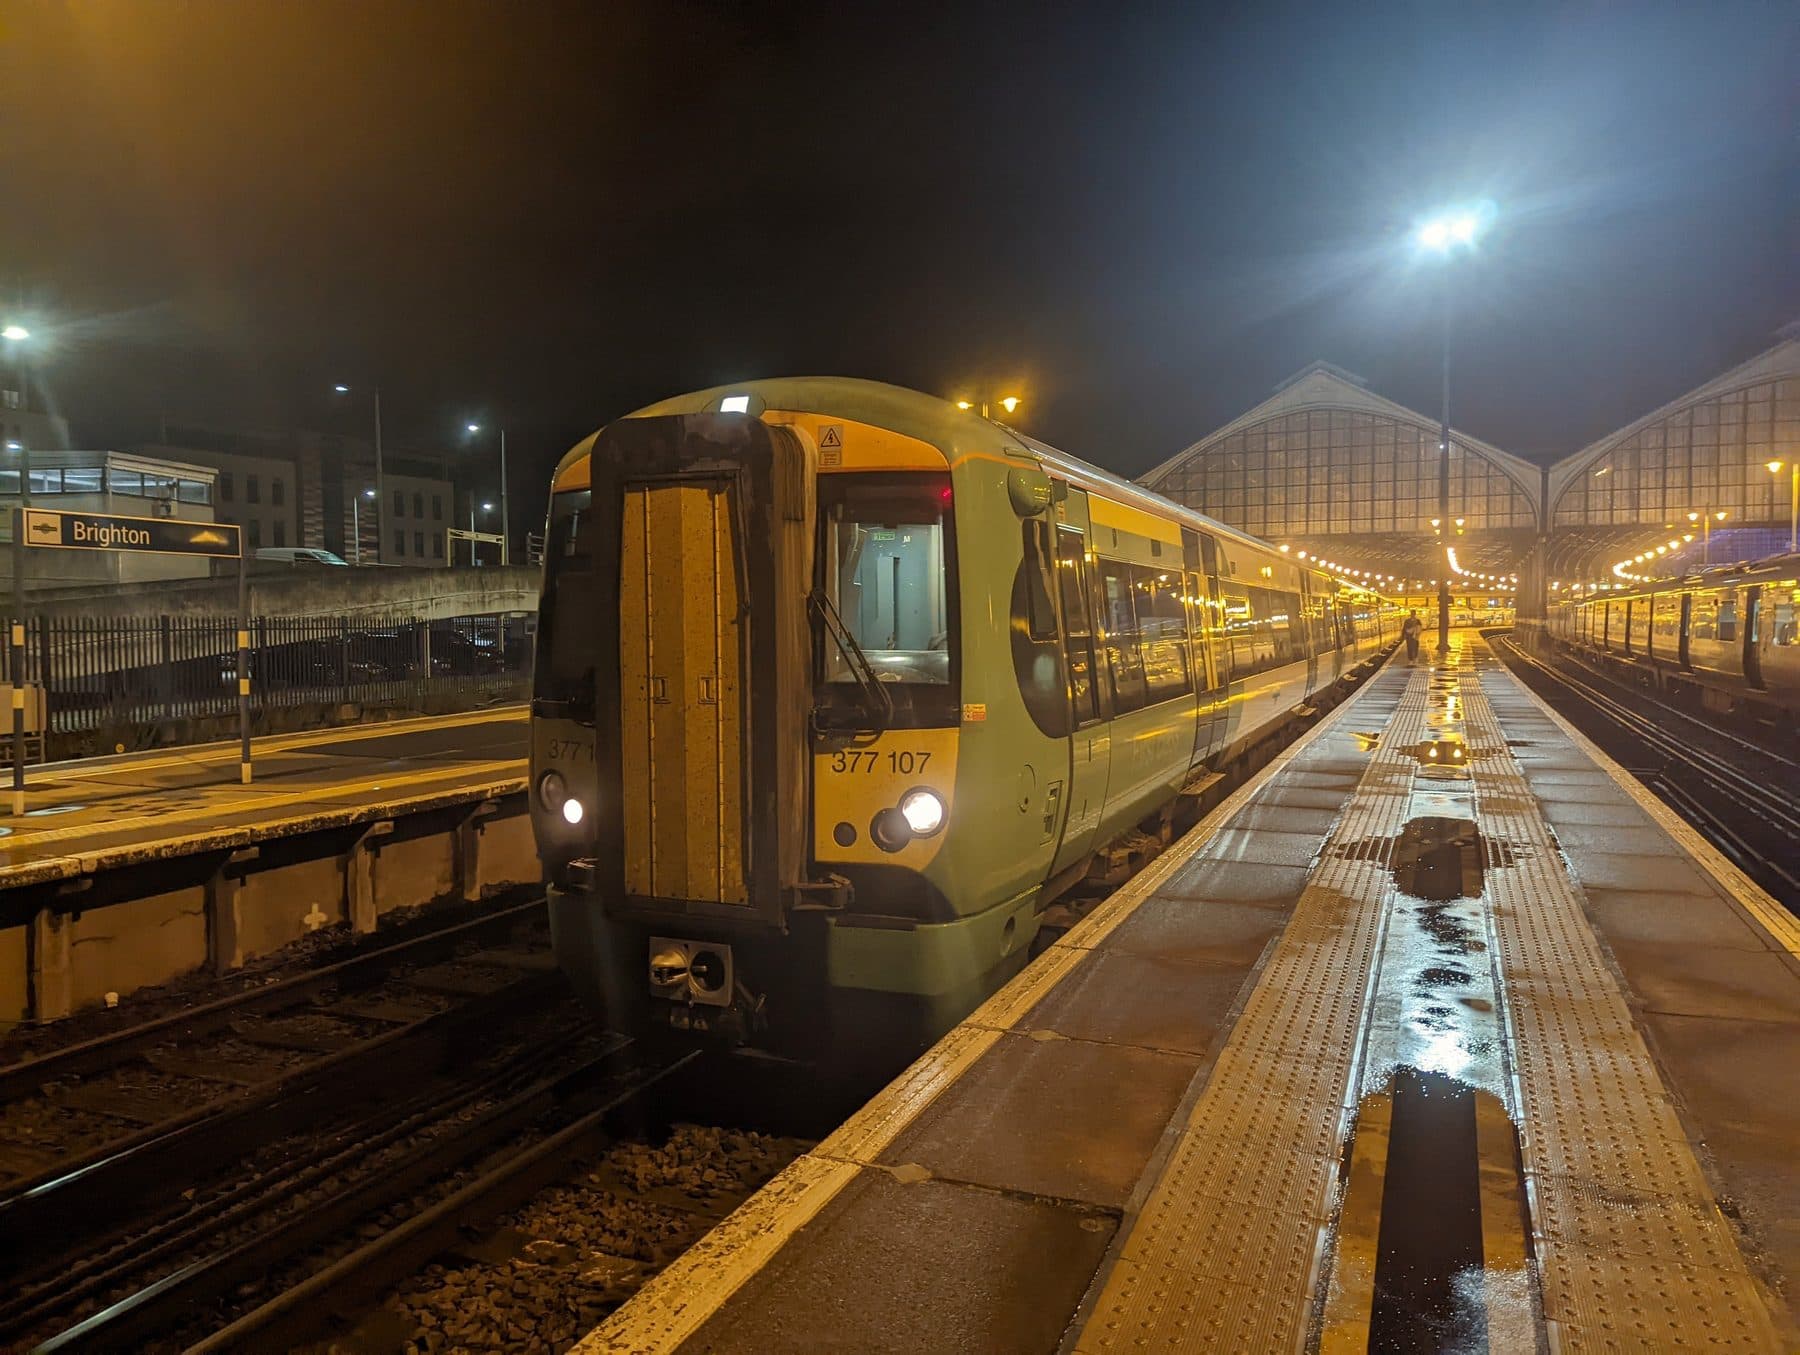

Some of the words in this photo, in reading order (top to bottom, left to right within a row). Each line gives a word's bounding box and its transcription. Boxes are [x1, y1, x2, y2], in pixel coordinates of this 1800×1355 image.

[73, 520, 150, 547] Brighton
[548, 738, 581, 760] 377
[831, 750, 879, 774] 377
[887, 750, 932, 774] 107
